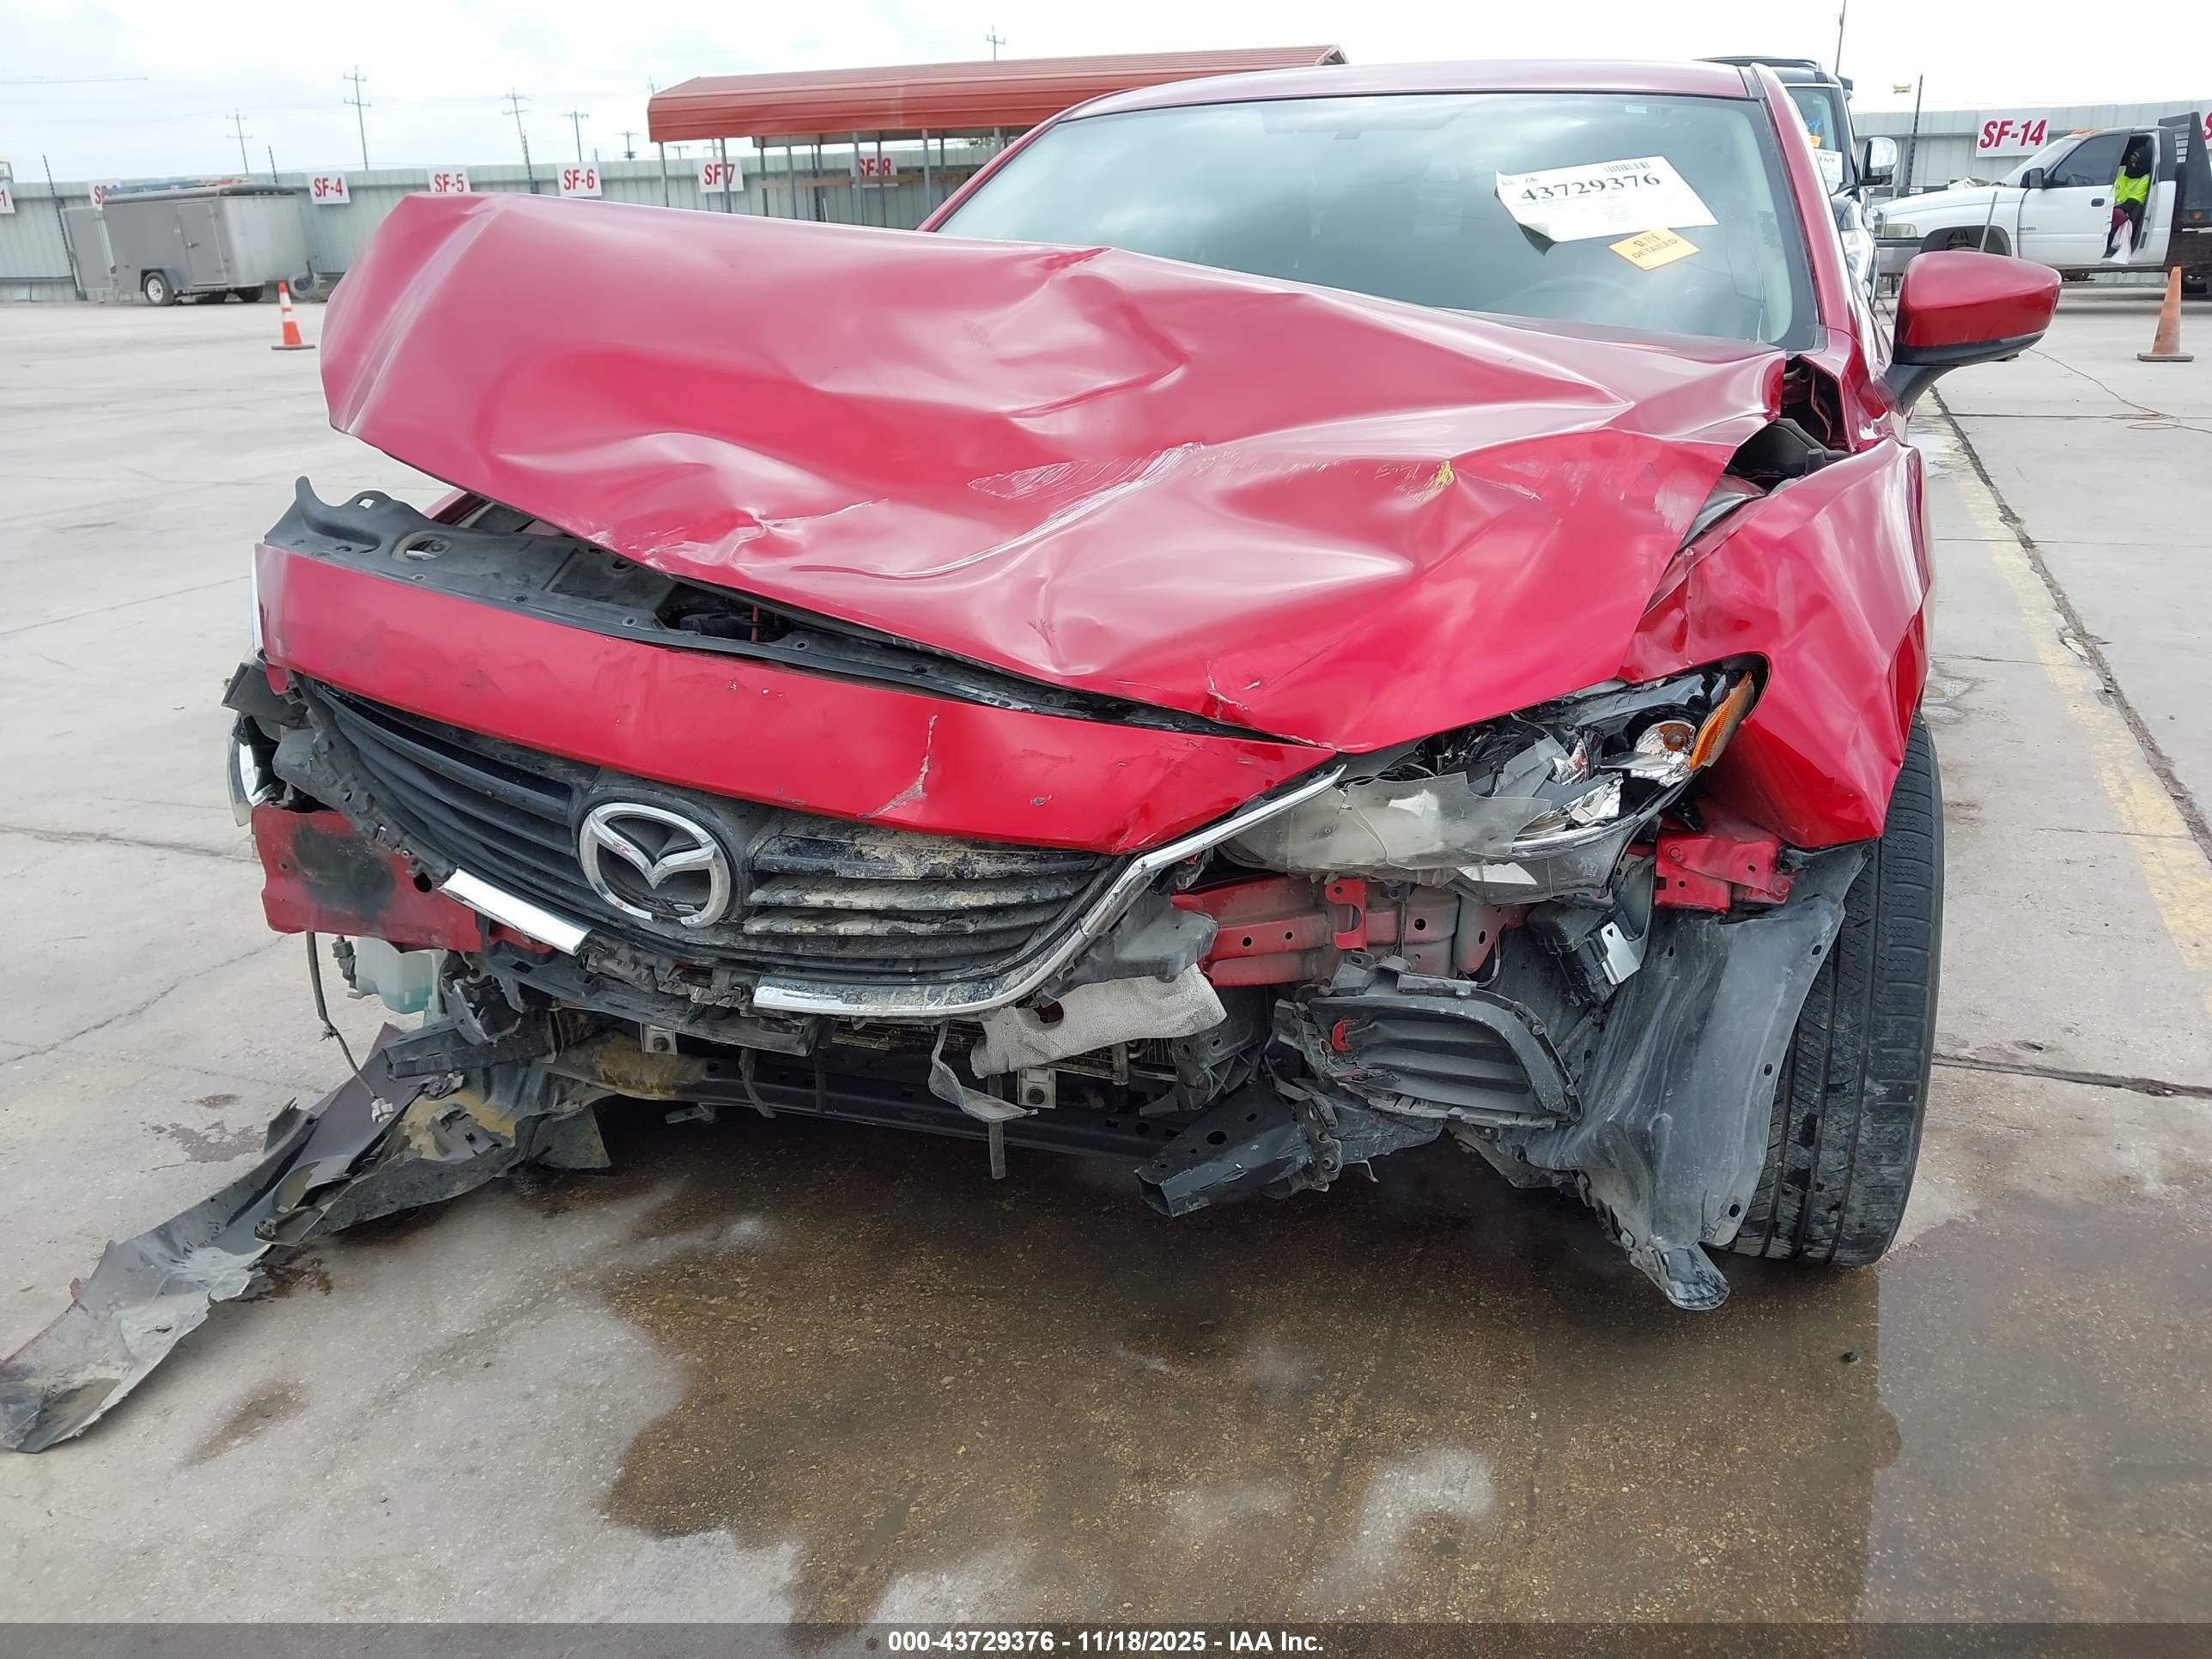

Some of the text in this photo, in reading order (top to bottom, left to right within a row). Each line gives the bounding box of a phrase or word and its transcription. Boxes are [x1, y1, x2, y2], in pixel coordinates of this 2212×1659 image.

[1979, 119, 2047, 149] SF-14
[434, 173, 465, 193] SF-5
[563, 169, 595, 191] SF-6
[704, 163, 735, 185] SF7
[314, 177, 343, 198] SF-4
[1521, 172, 1661, 202] 43729376
[1631, 238, 1679, 259] DETAILED
